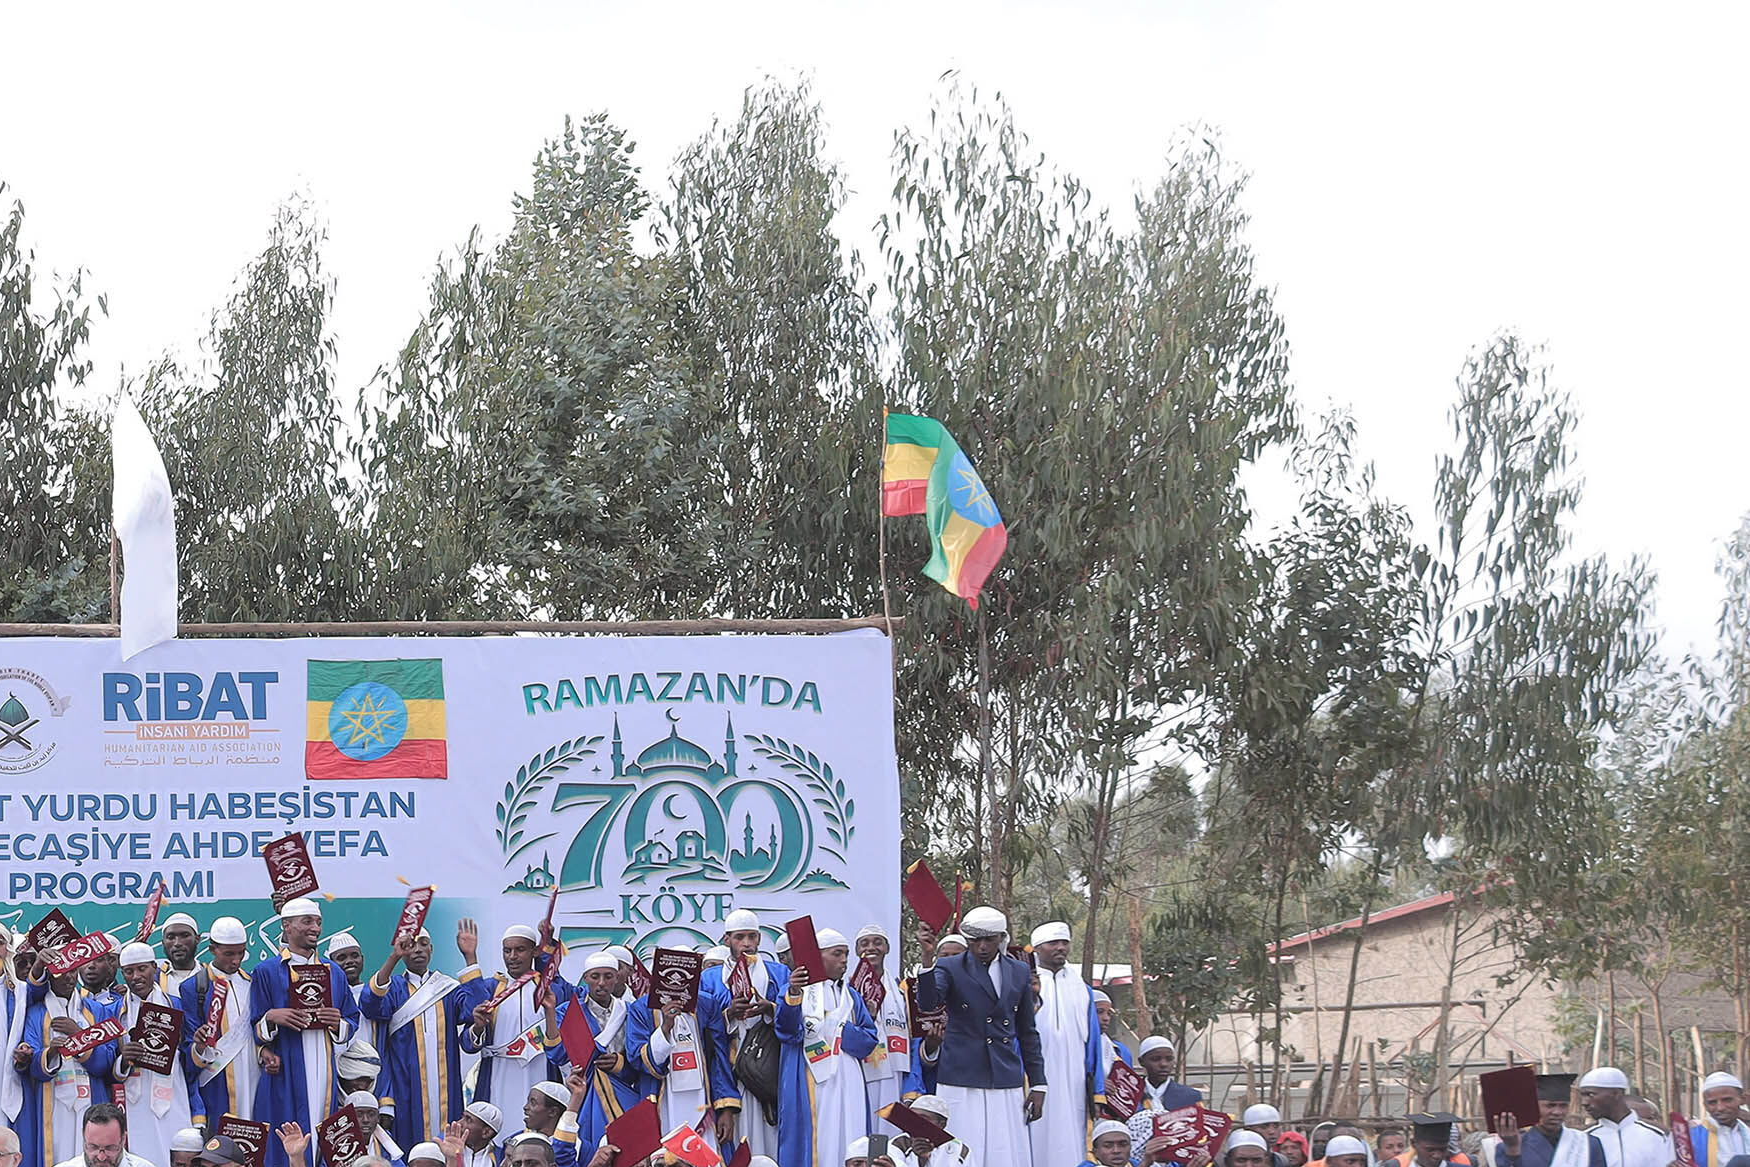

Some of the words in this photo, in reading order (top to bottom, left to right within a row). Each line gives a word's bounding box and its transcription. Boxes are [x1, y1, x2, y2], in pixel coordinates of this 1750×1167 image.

[191, 724, 247, 737] YARDIM
[104, 743, 185, 753] HUMANITARIAN
[189, 743, 208, 753] AID
[212, 742, 282, 752] ASSOCIATION
[29, 793, 157, 822] YURDU
[169, 784, 416, 827] HABEŞİSTAN
[550, 779, 813, 895] 700
[9, 869, 215, 900] PROGRAMI
